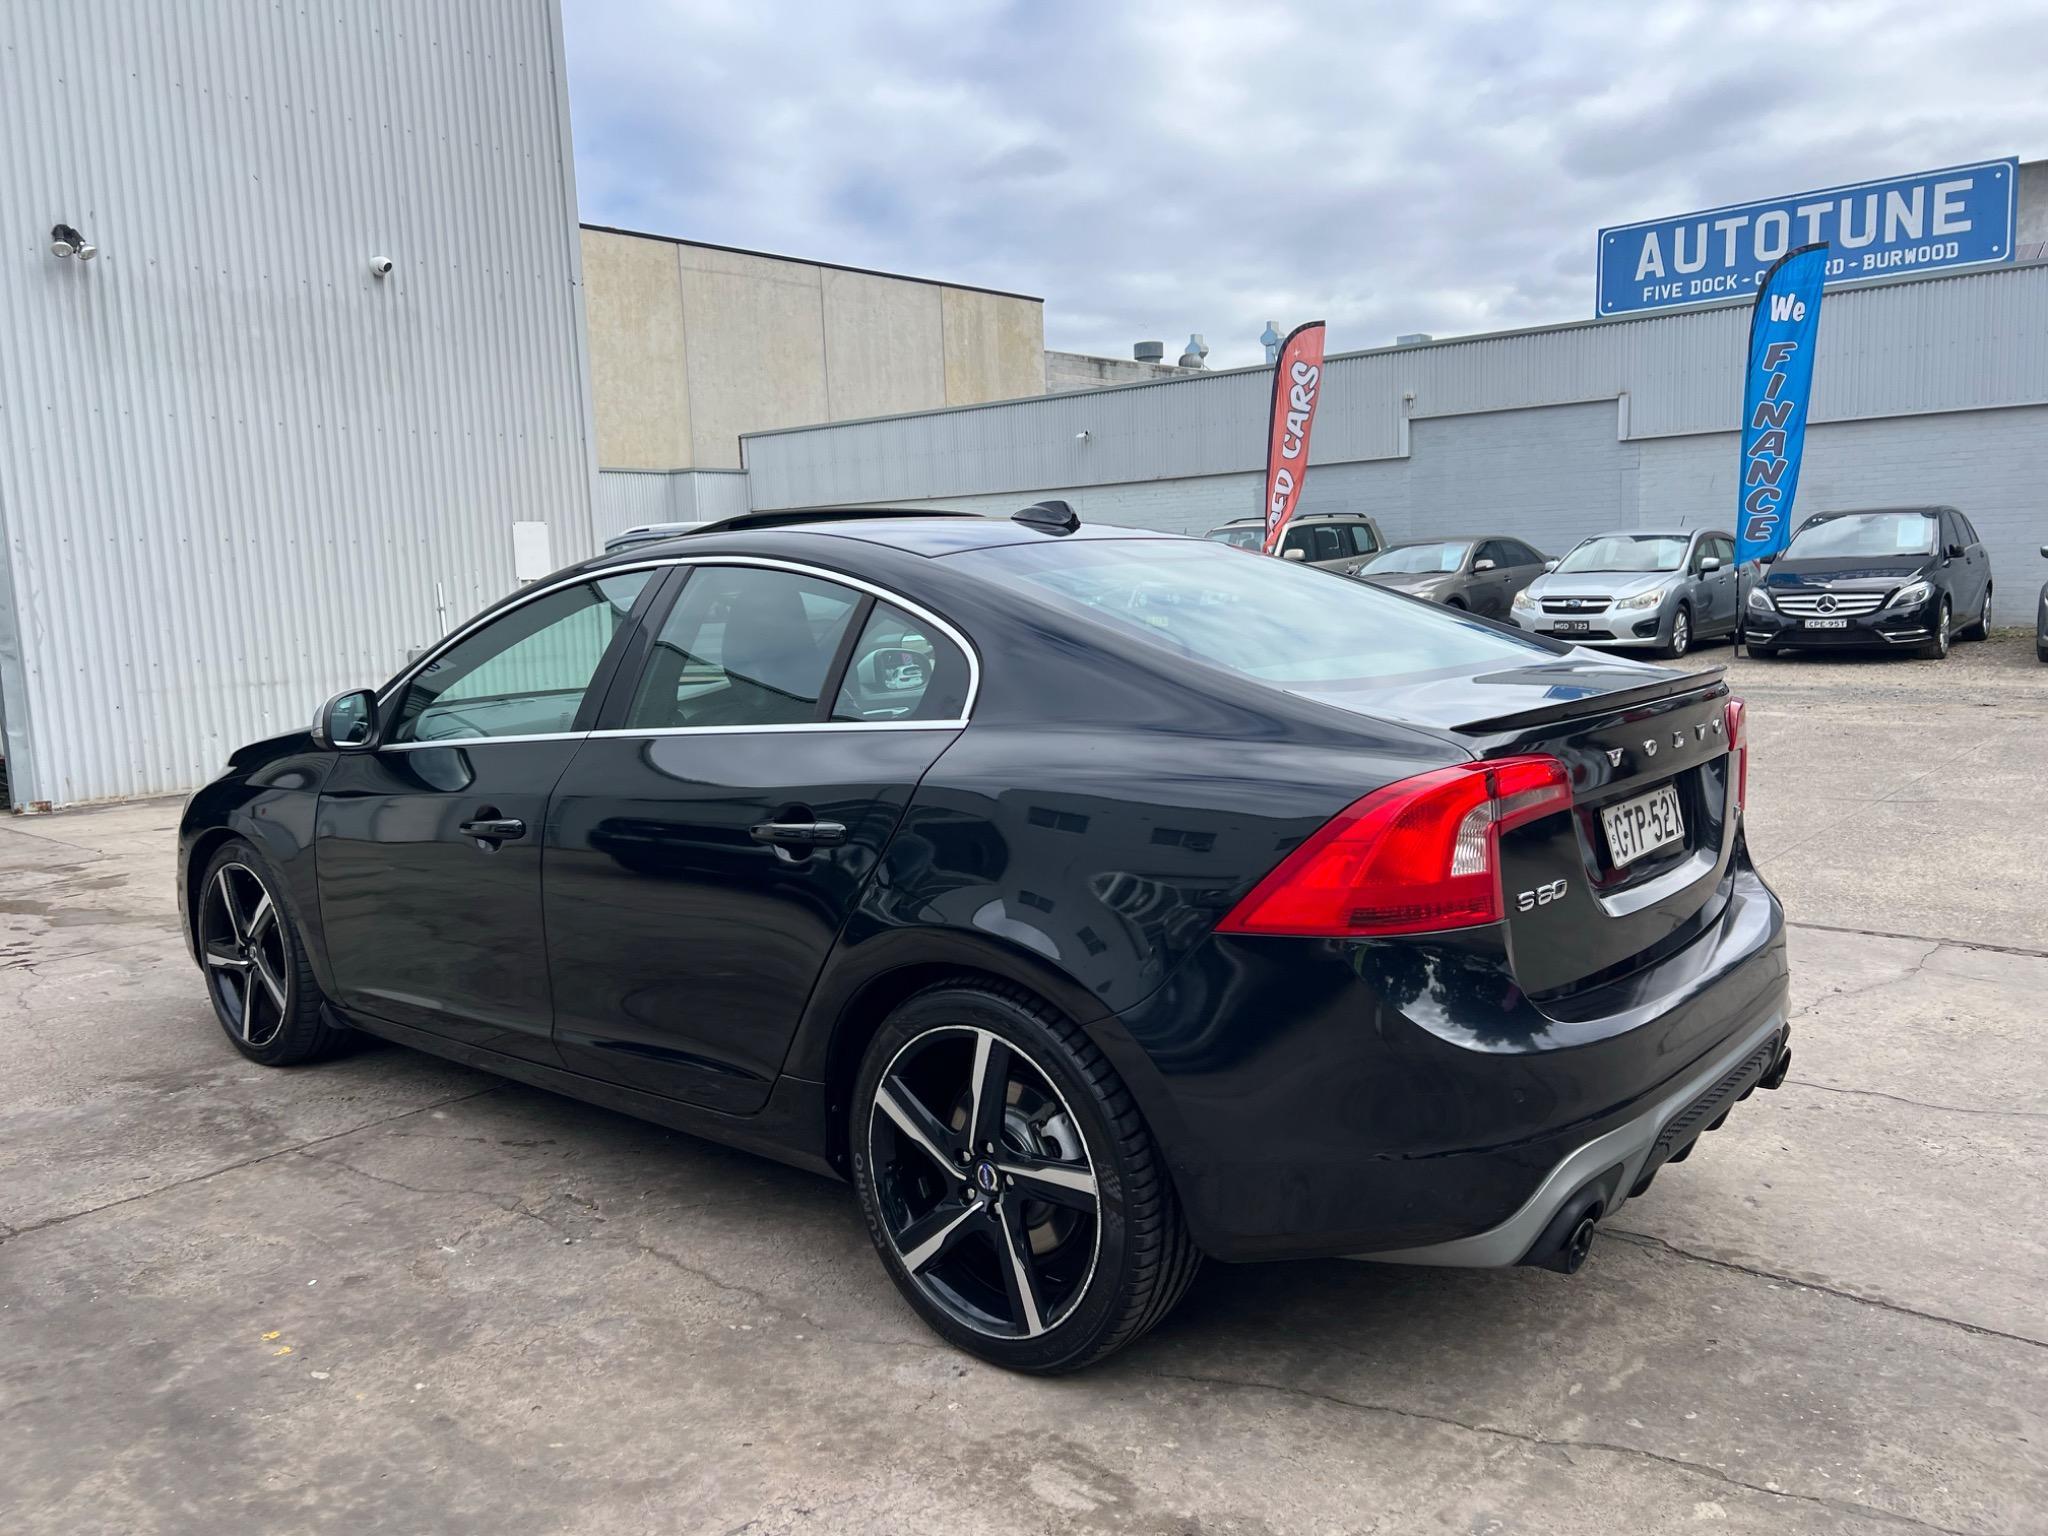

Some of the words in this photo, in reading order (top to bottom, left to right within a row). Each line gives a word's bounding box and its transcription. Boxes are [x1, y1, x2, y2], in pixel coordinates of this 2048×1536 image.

[1634, 178, 1974, 282] AUTOTUNE
[1643, 282, 1682, 302] FIVE
[1863, 241, 1959, 271] BURWOOD
[1770, 293, 1806, 322] We
[1282, 361, 1320, 460] CARS
[1744, 341, 1798, 542] FINANCE
[1606, 718, 1723, 768] VOLVO
[1516, 878, 1568, 912] S60
